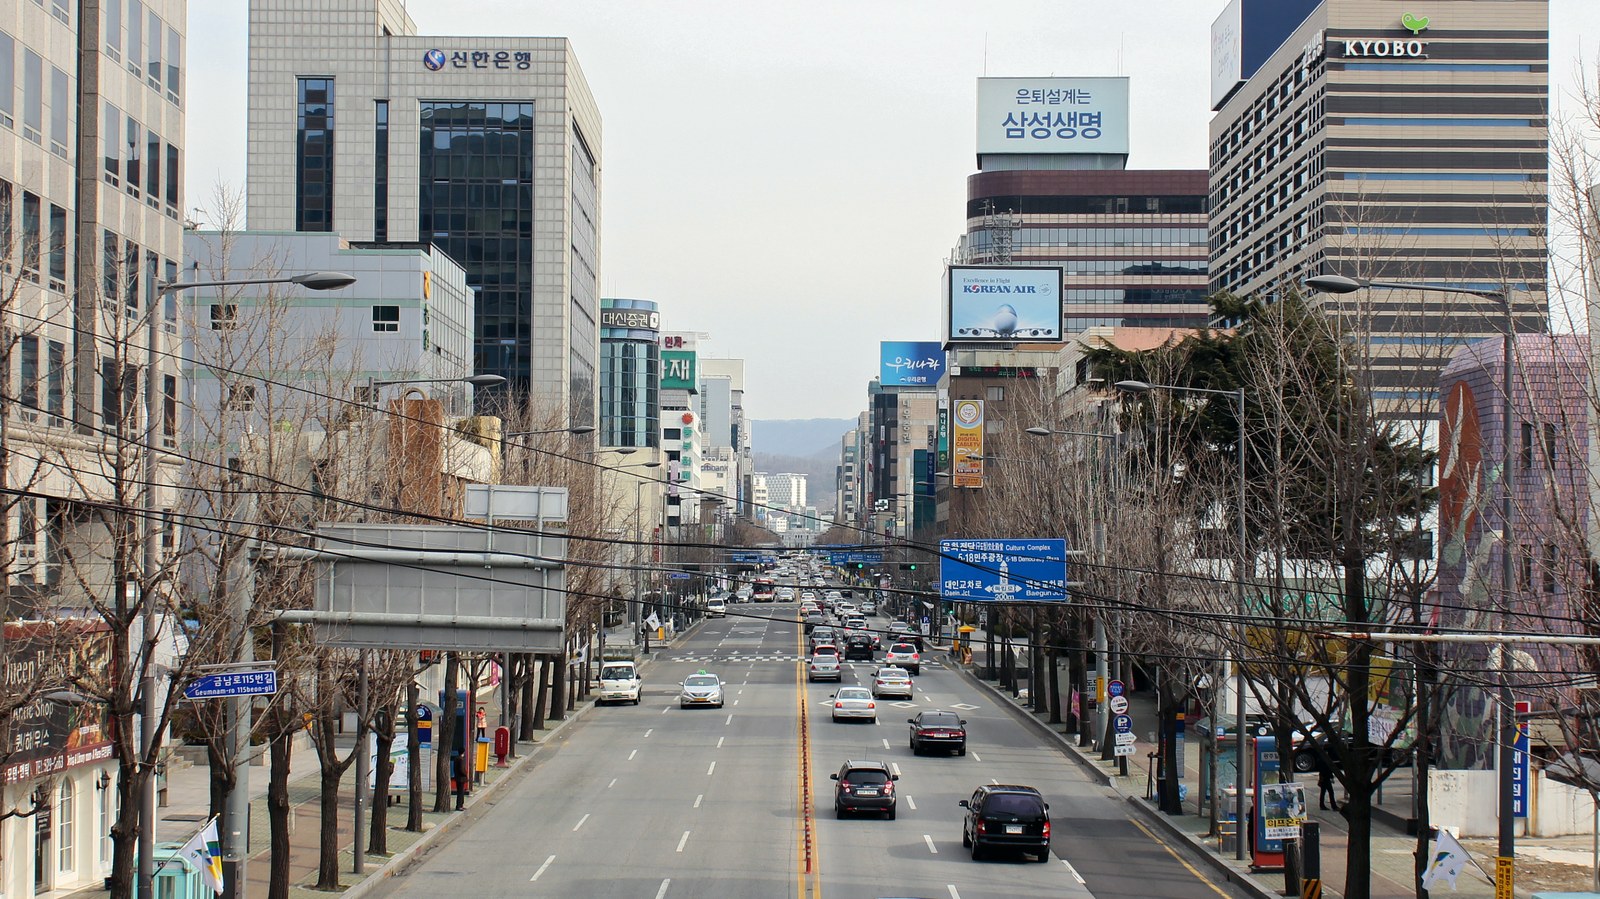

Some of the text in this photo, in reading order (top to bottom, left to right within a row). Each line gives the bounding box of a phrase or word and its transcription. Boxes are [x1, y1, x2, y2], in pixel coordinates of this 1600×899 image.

[1345, 40, 1422, 57] KYOBO
[450, 51, 532, 70] 신한은행
[1015, 88, 1092, 105] 은퇴설계는
[1001, 111, 1102, 140] 삼성생명
[963, 284, 1036, 294] KOREAN AIR
[602, 312, 648, 328] 대신증권
[885, 356, 941, 374] 우리나라
[902, 399, 912, 444] 대우증권
[939, 412, 947, 438] 하나은행
[944, 579, 983, 590] 대인교차로
[994, 593, 1015, 601] 200m
[1025, 589, 1052, 598] Baegun
[213, 672, 273, 687] 금남로115번길
[194, 684, 274, 697] Geumnam-ro 115beon-gil
[34, 697, 55, 720] Shop
